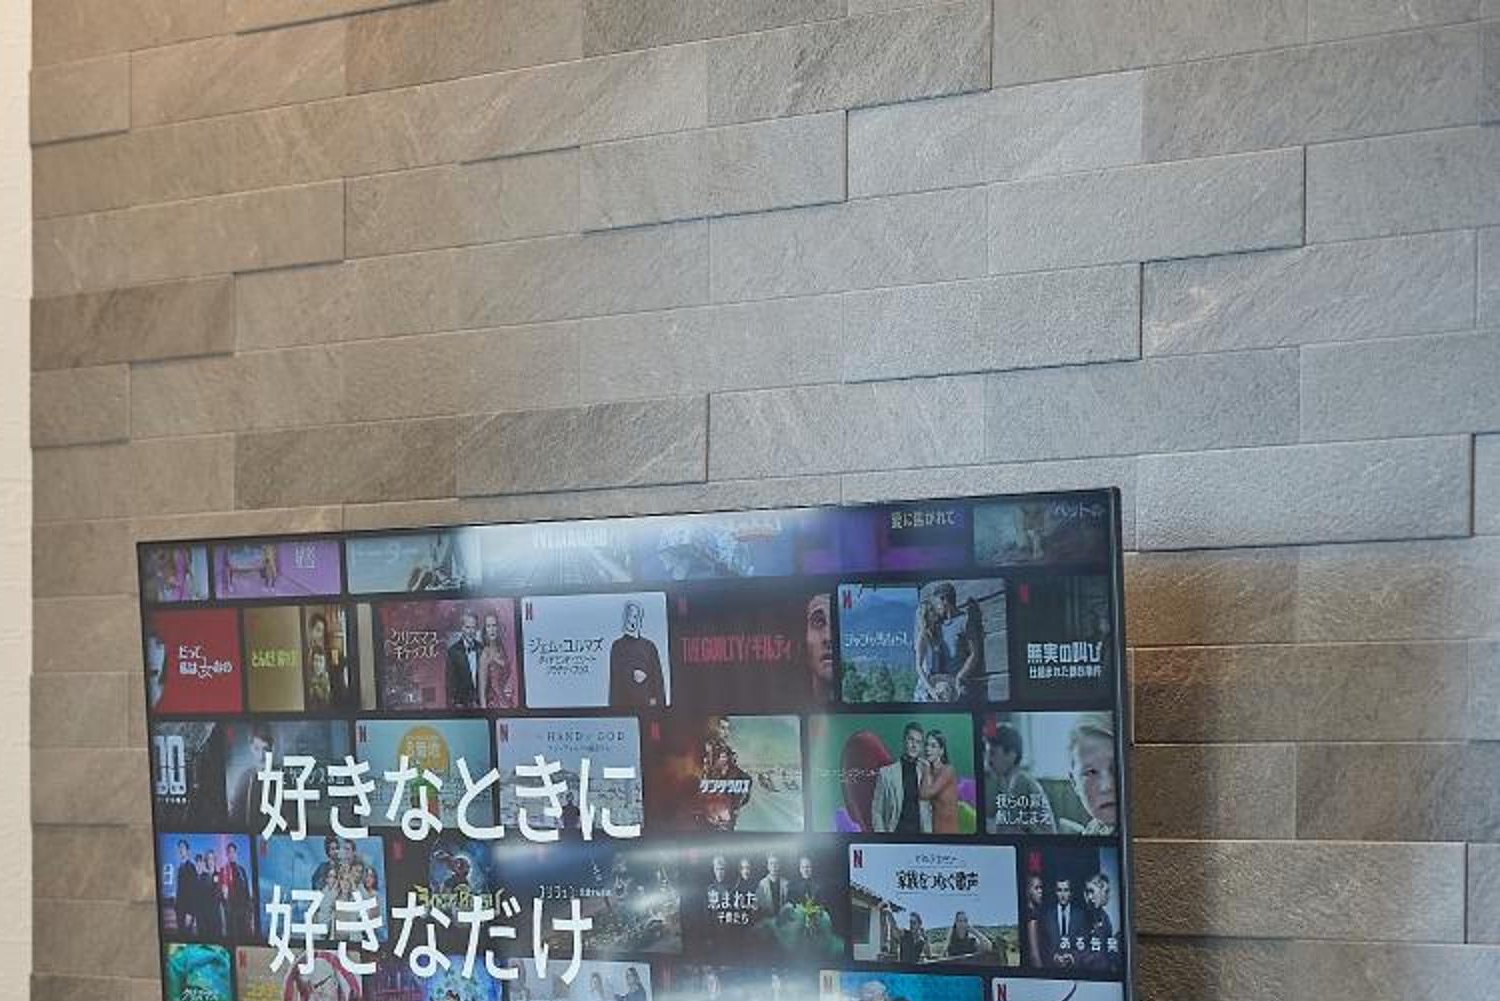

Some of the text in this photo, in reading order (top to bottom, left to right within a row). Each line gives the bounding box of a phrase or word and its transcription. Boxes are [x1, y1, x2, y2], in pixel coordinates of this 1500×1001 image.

[258, 752, 641, 842] 好きなときに
[266, 886, 593, 984] 好きなだけ
